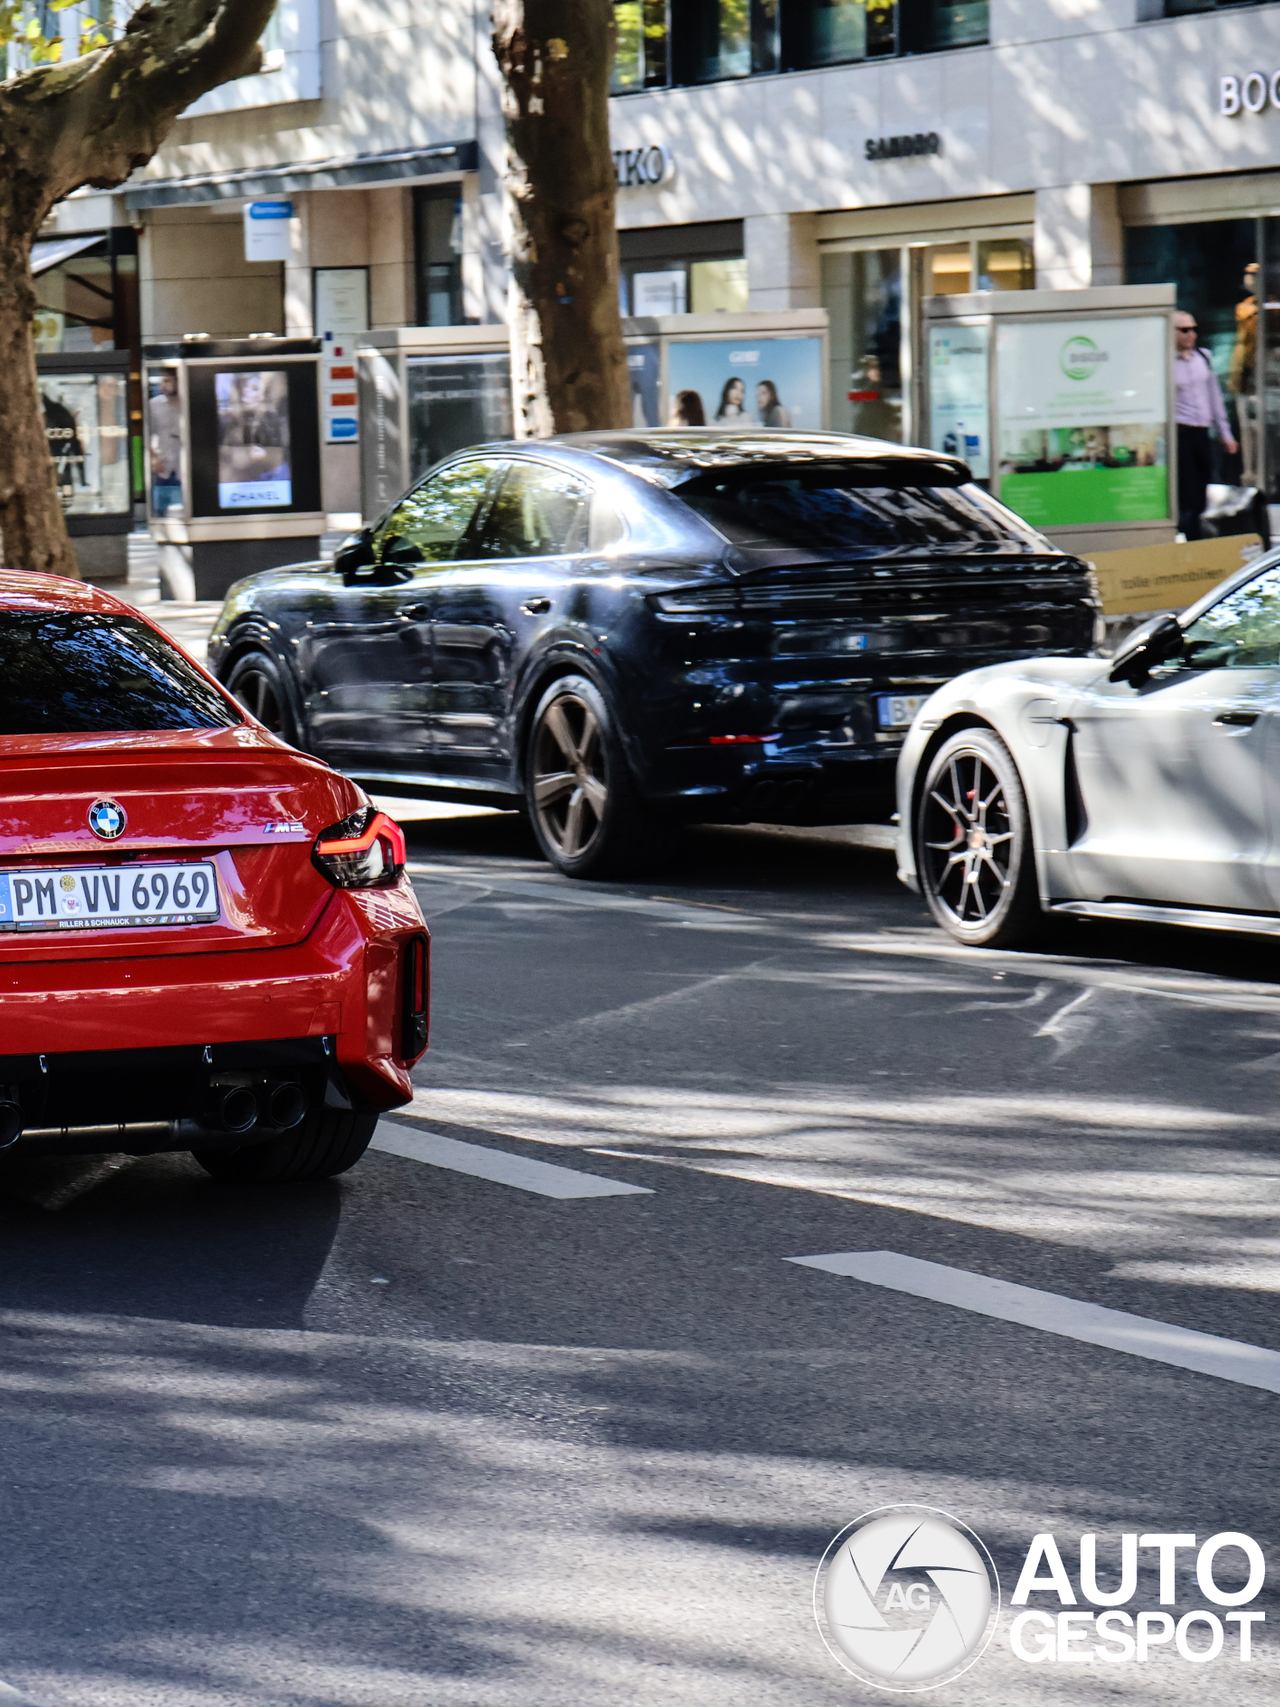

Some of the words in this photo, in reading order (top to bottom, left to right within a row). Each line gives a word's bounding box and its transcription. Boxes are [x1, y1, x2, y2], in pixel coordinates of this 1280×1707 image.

[865, 131, 939, 161] SANDRO
[231, 489, 280, 503] CHANEL
[264, 821, 304, 833] M2
[13, 878, 57, 916] PM
[81, 874, 120, 913] VV
[132, 871, 210, 911] 6969
[59, 919, 84, 928] RILLER
[84, 919, 90, 927] &
[90, 918, 130, 927] SCHNAUCK
